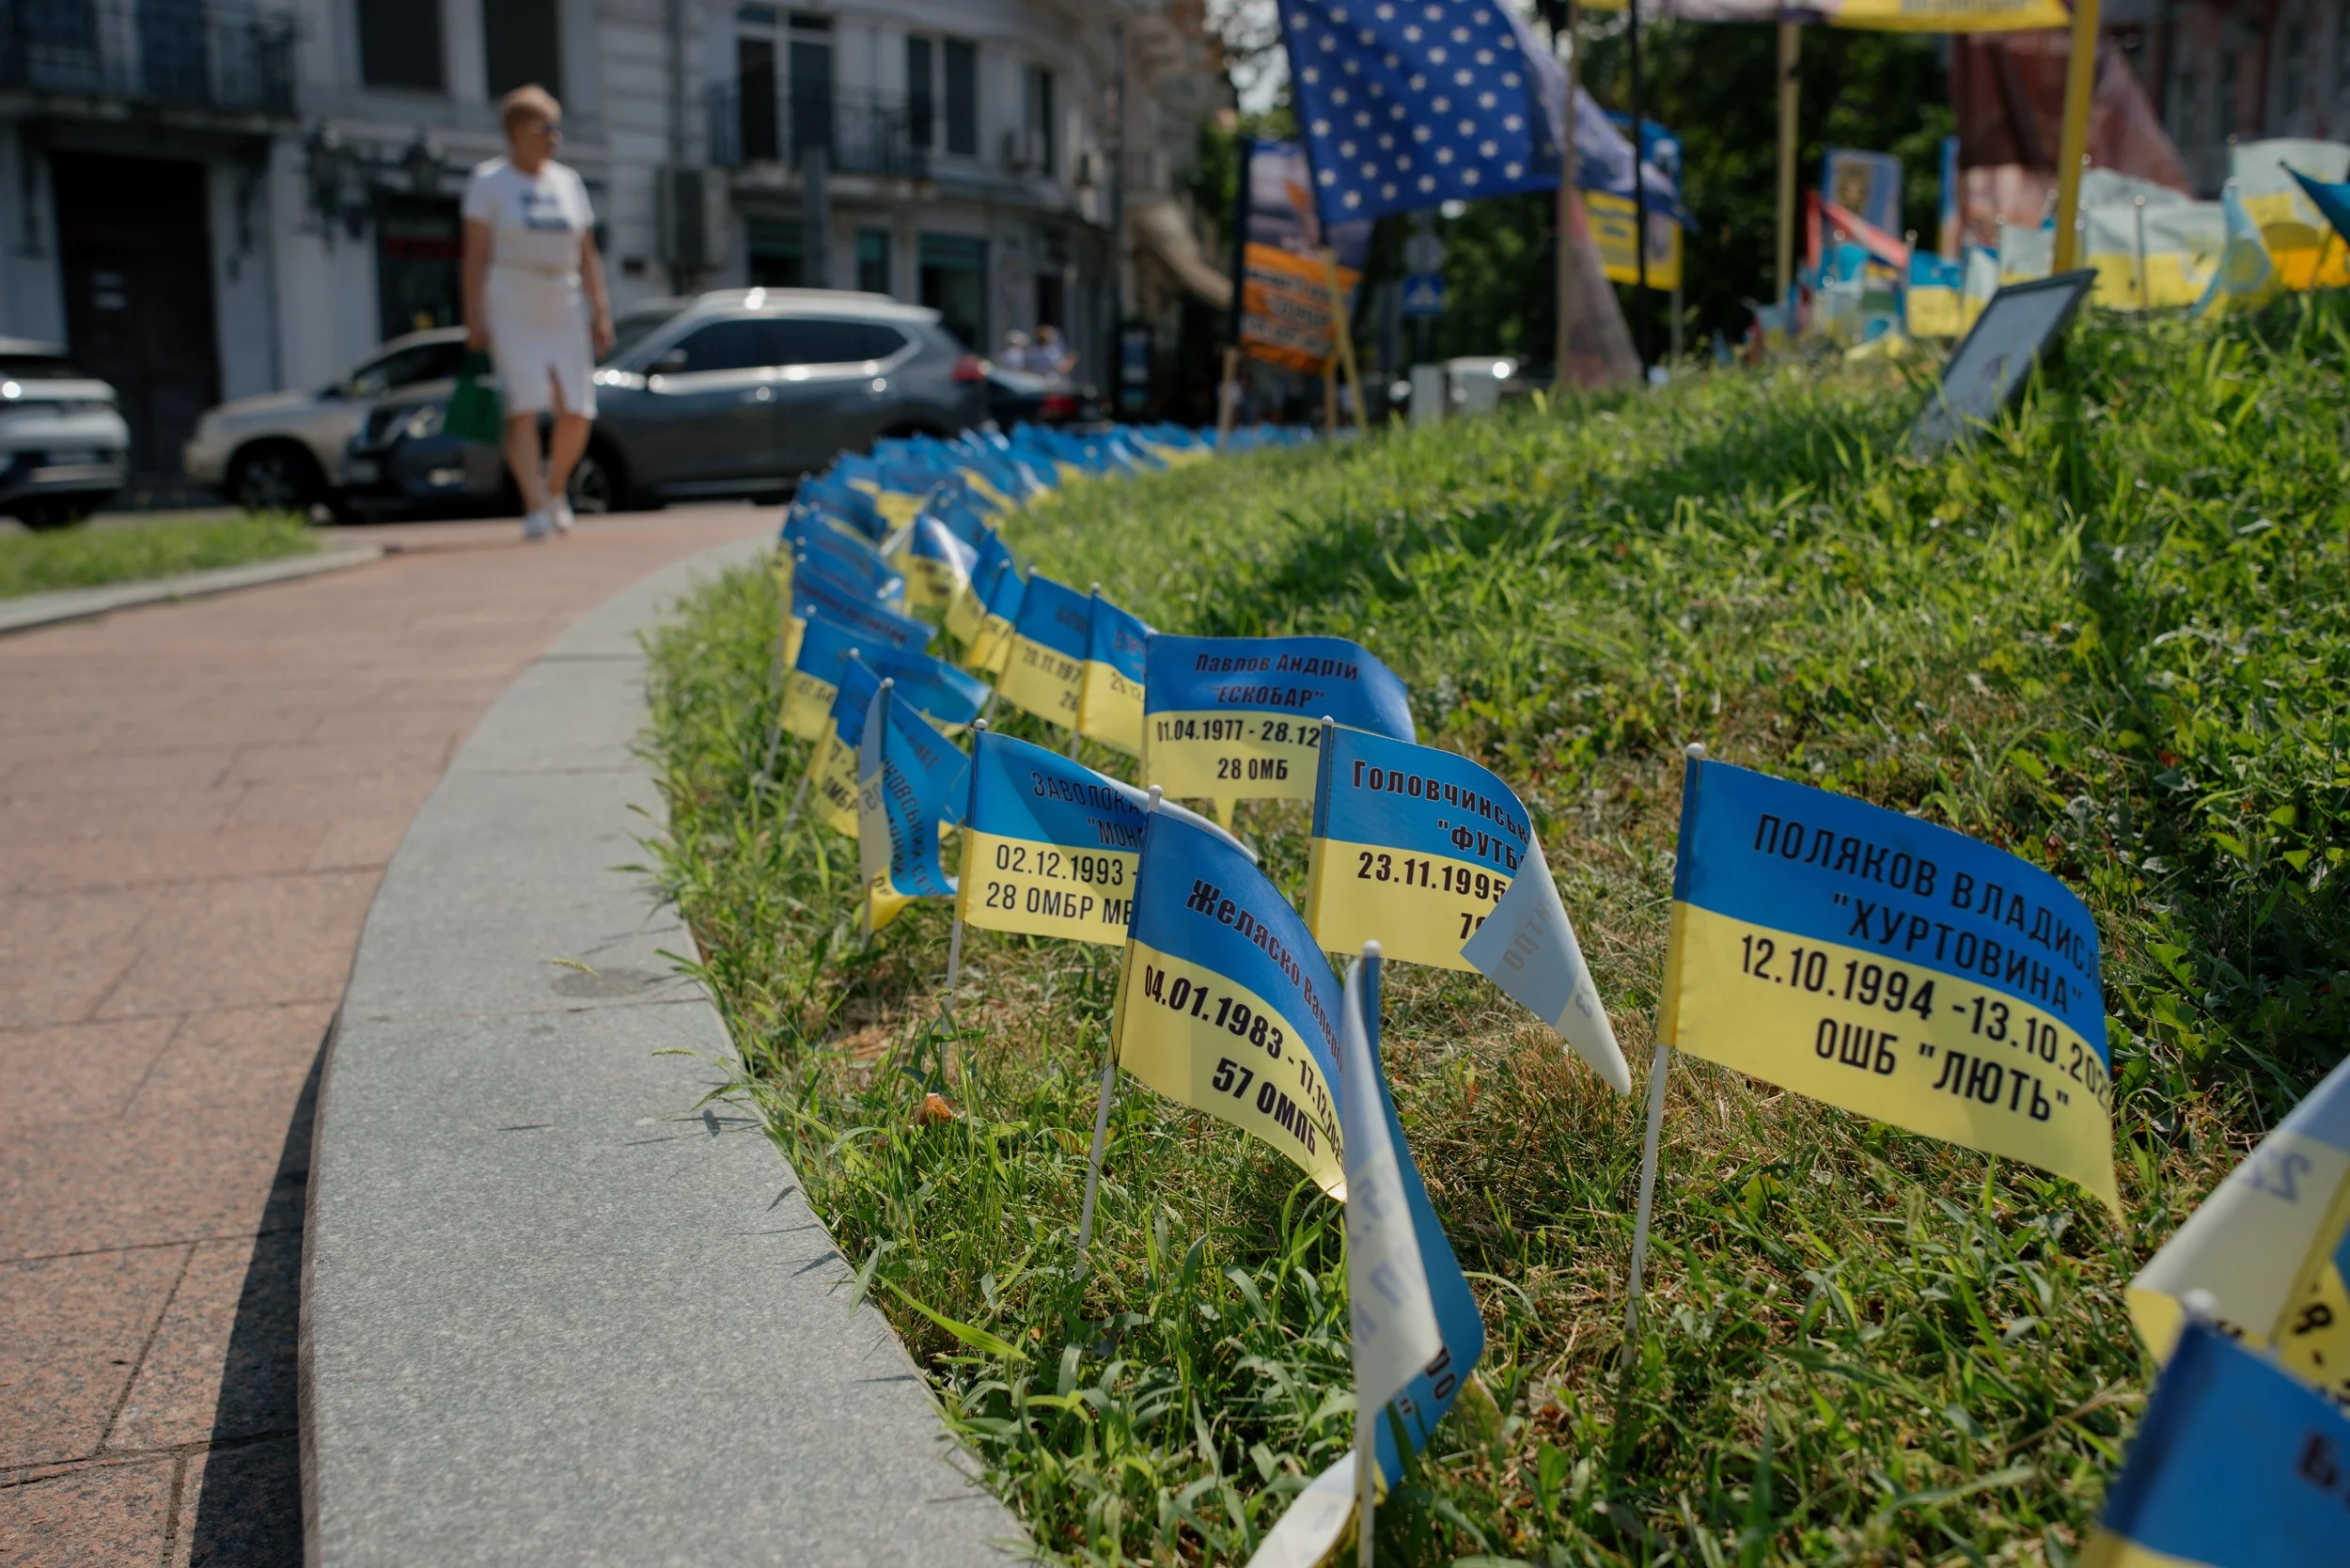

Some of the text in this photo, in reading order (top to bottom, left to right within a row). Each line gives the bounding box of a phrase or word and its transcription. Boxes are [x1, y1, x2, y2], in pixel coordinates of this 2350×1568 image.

[1195, 653, 1359, 682] Павлов Андрій
[1211, 685, 1324, 708] "ЕСКОБАР"
[1216, 758, 1289, 781] 28 ОМБ
[1353, 759, 1530, 846] Головчинськ
[995, 843, 1124, 886] 02.12.1993
[1356, 851, 1506, 905] 23.11.1995
[1753, 813, 1938, 898] ПОЛЯКОВ
[986, 880, 1016, 911] 28
[1026, 886, 1094, 920] ОМБР
[1185, 878, 1300, 987] Желяско
[1832, 892, 2083, 1015] "ХУРТОВИНА"
[1144, 964, 1284, 1060] 04.01.1983
[1741, 933, 2109, 1114] 12.10.1994 -13.10.202
[1211, 1057, 1316, 1157] 57 ОМПБ
[1815, 1018, 2071, 1123] ОШБ "ЛЮТЬ"
